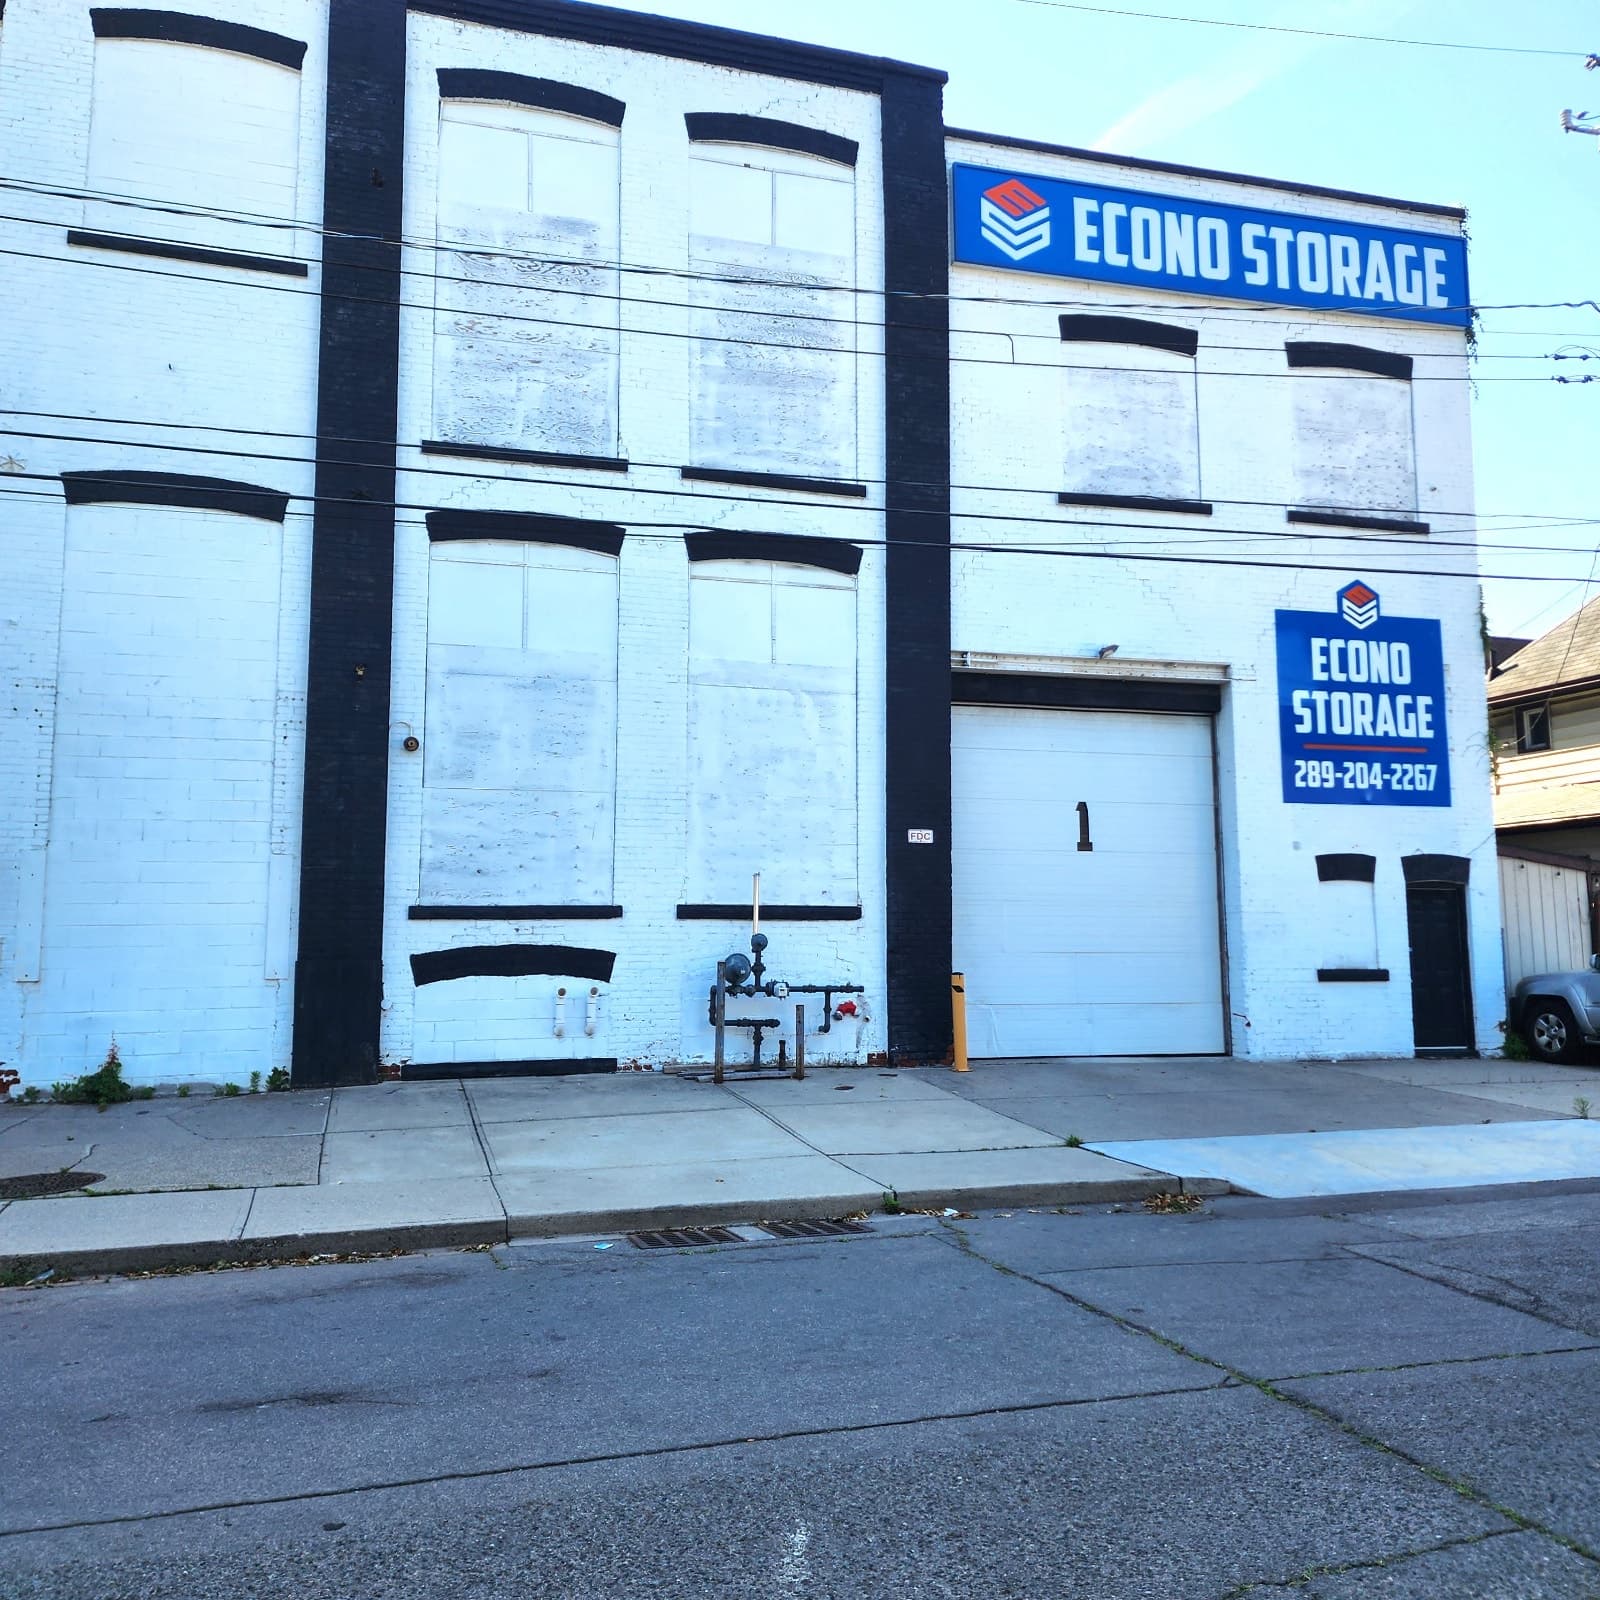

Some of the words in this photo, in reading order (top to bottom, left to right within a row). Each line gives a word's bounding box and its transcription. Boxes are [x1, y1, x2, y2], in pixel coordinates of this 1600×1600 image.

[1073, 197, 1230, 281] ECONO
[1241, 222, 1449, 308] STORAGE
[1311, 637, 1411, 685] ECONO
[1292, 689, 1434, 738] STORAGE
[1294, 759, 1438, 791] 289-204-2267
[910, 832, 931, 841] FDC
[1075, 801, 1093, 852] 1
